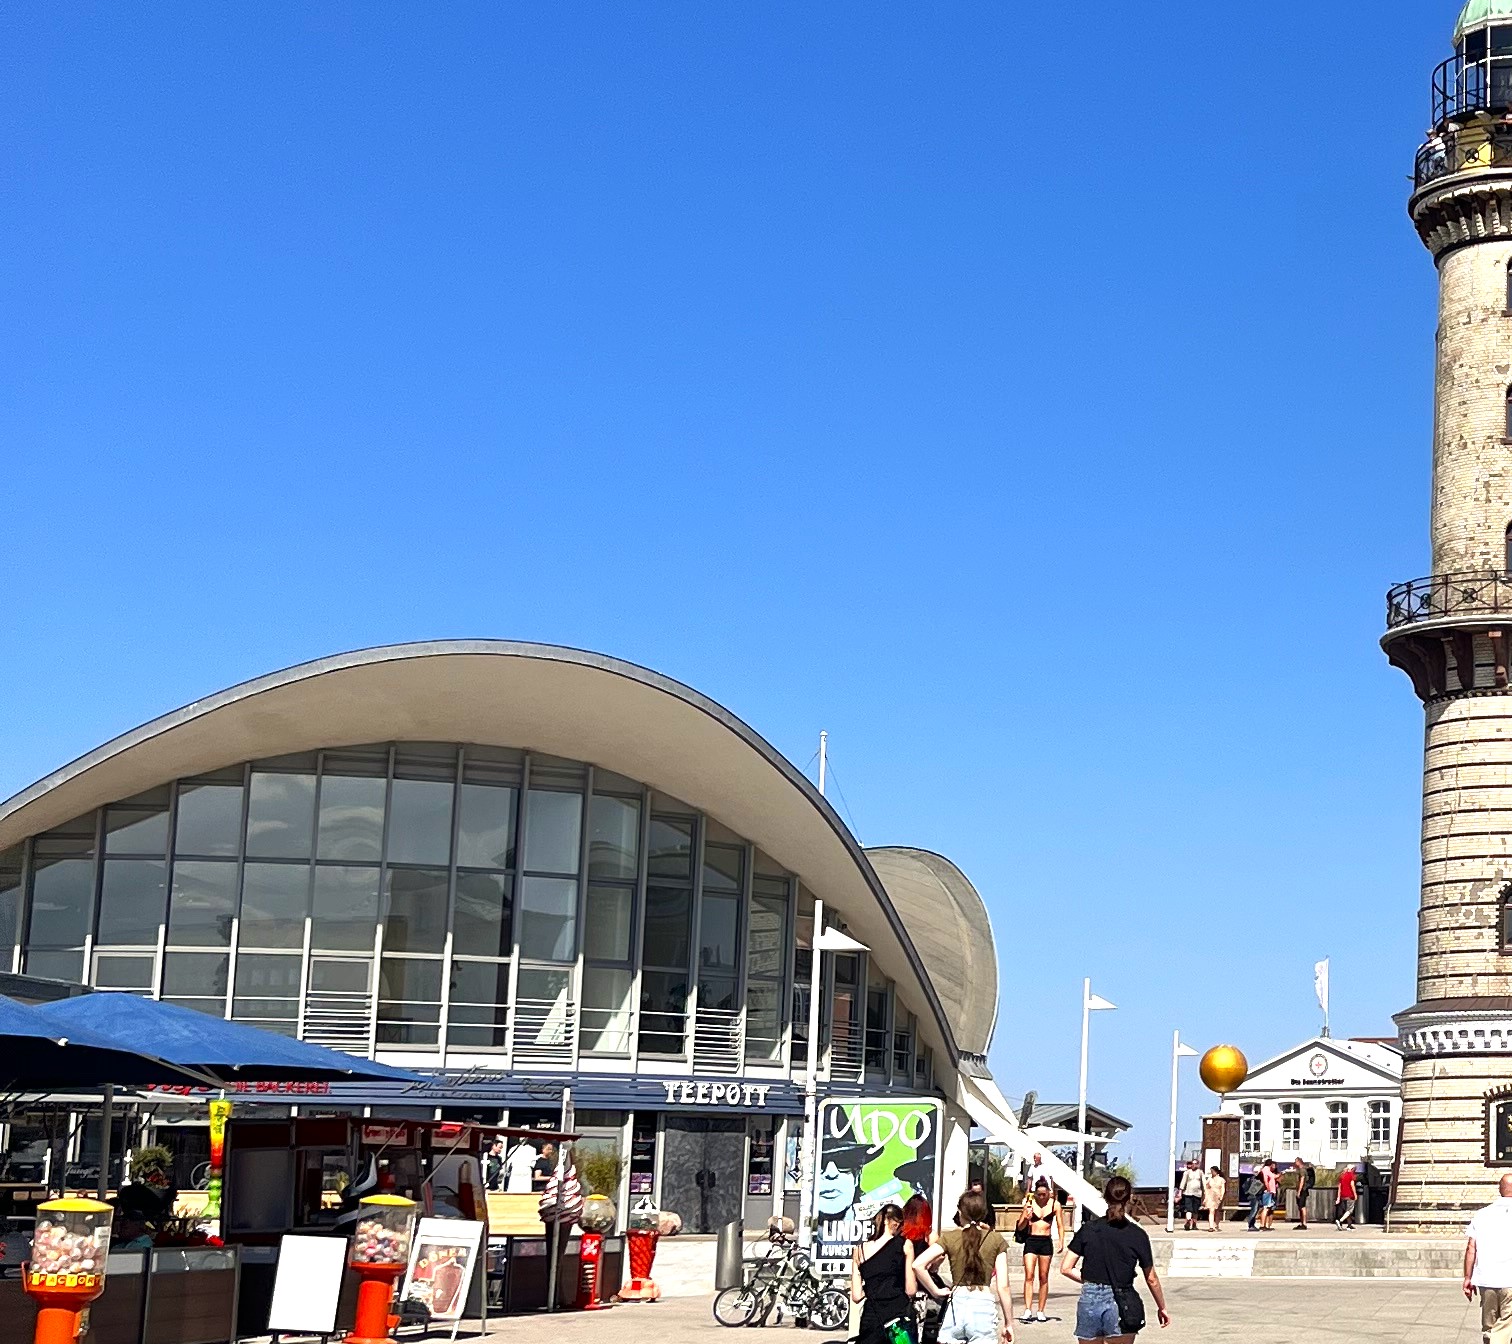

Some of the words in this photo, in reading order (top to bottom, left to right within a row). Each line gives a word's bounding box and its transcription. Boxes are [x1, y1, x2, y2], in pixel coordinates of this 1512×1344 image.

[662, 1081, 770, 1106] TEEPOTT
[830, 1105, 931, 1154] UDO
[821, 1244, 857, 1257] KUNST
[40, 1274, 100, 1287] FACTORY
